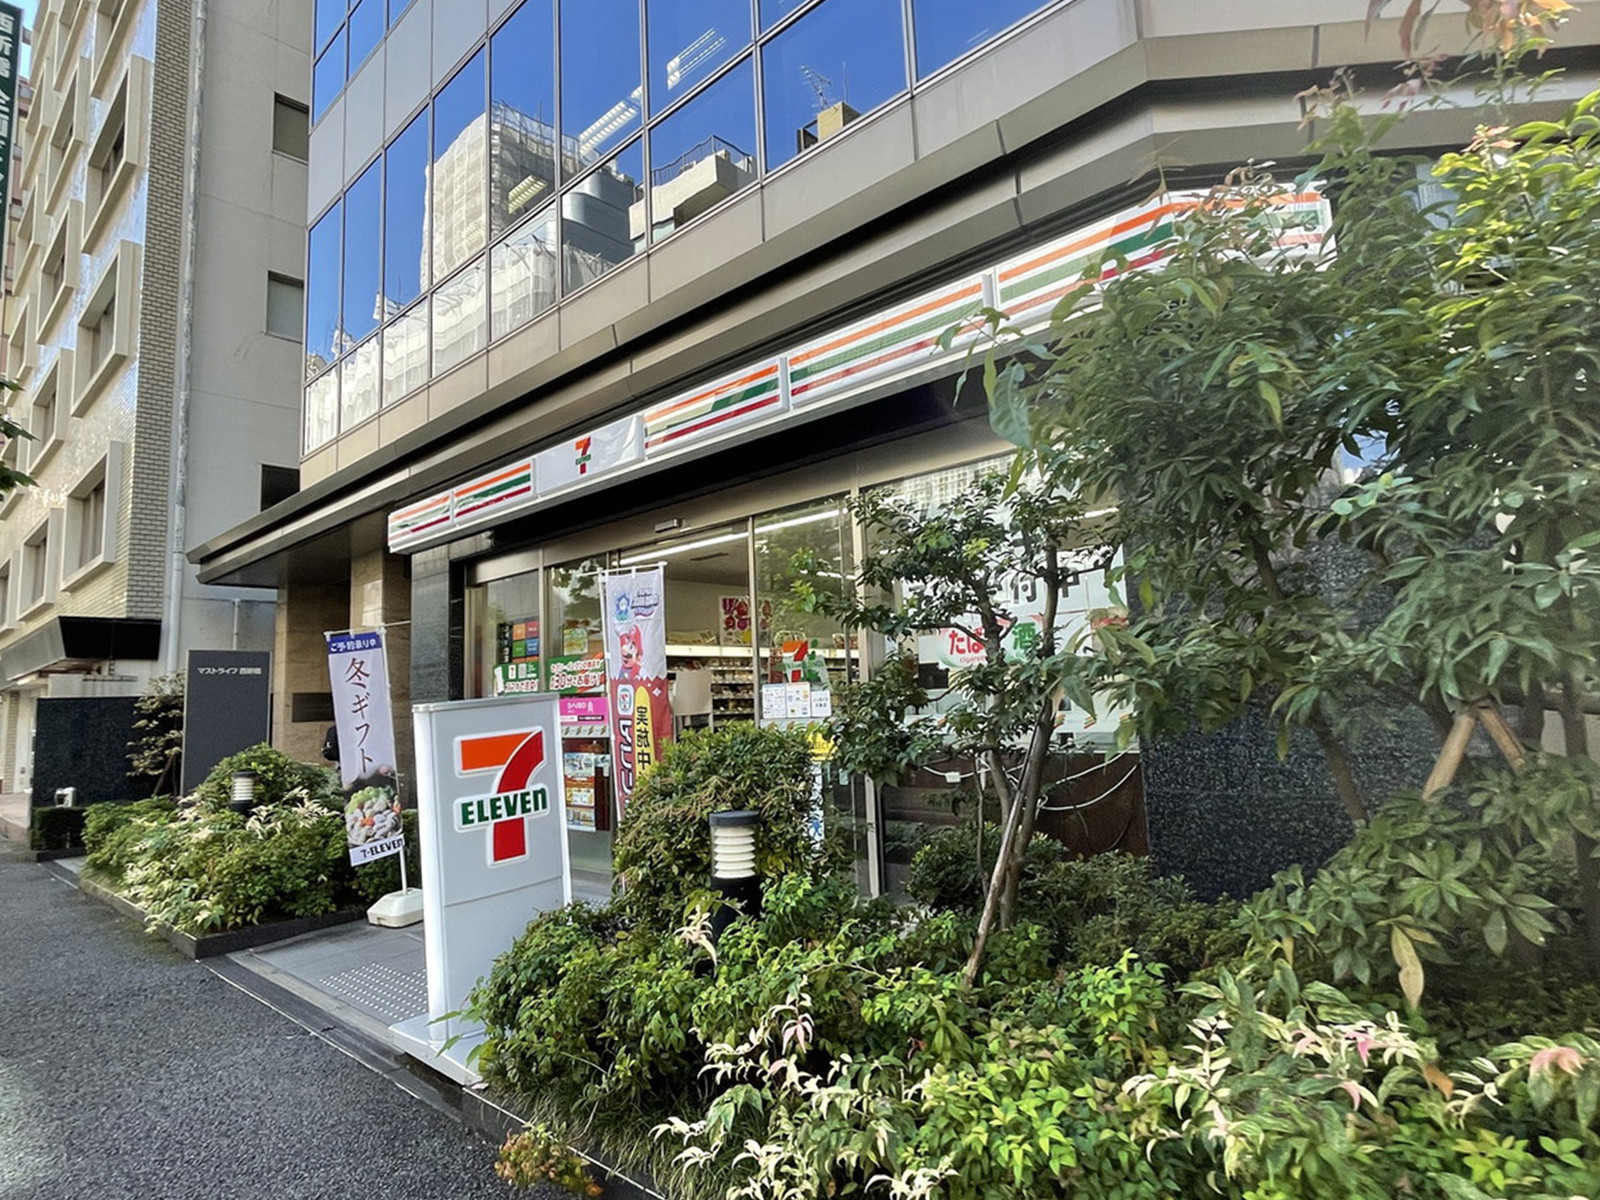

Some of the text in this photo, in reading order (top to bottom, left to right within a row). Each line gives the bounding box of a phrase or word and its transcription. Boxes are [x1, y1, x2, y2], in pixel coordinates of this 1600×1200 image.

[948, 627, 986, 655] たば
[1012, 622, 1036, 650] 酒
[344, 657, 374, 773] 冬ギフト
[460, 731, 544, 862] 7
